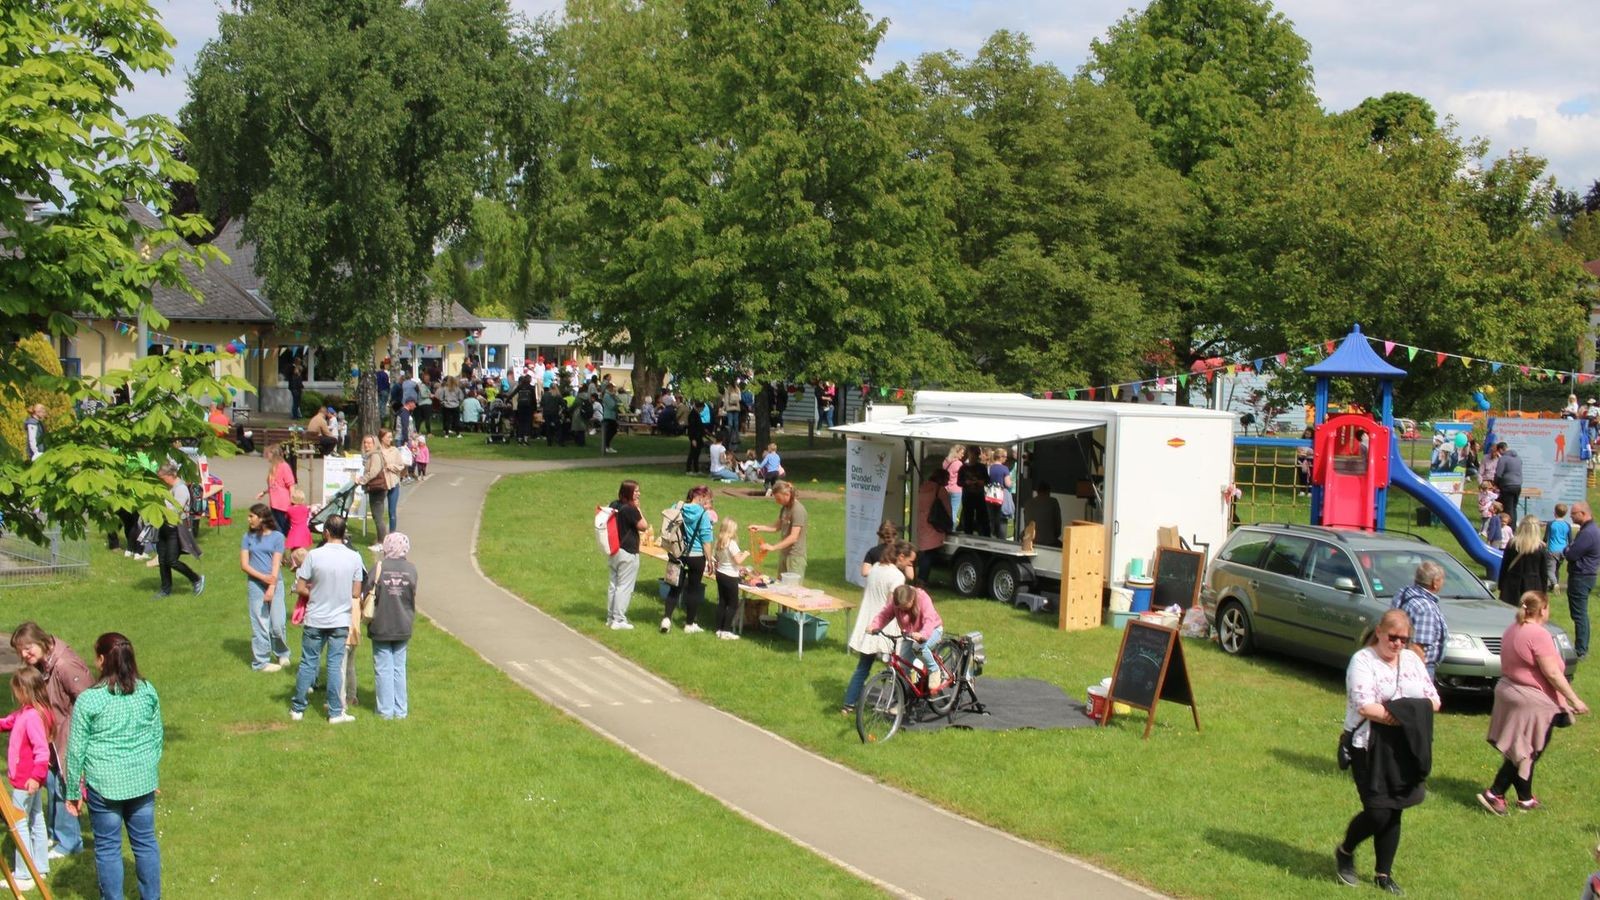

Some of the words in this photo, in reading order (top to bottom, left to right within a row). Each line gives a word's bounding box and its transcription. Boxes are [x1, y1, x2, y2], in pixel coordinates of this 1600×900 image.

[851, 464, 863, 473] Den
[851, 473, 872, 483] Wandel
[850, 482, 881, 492] verwurzeln
